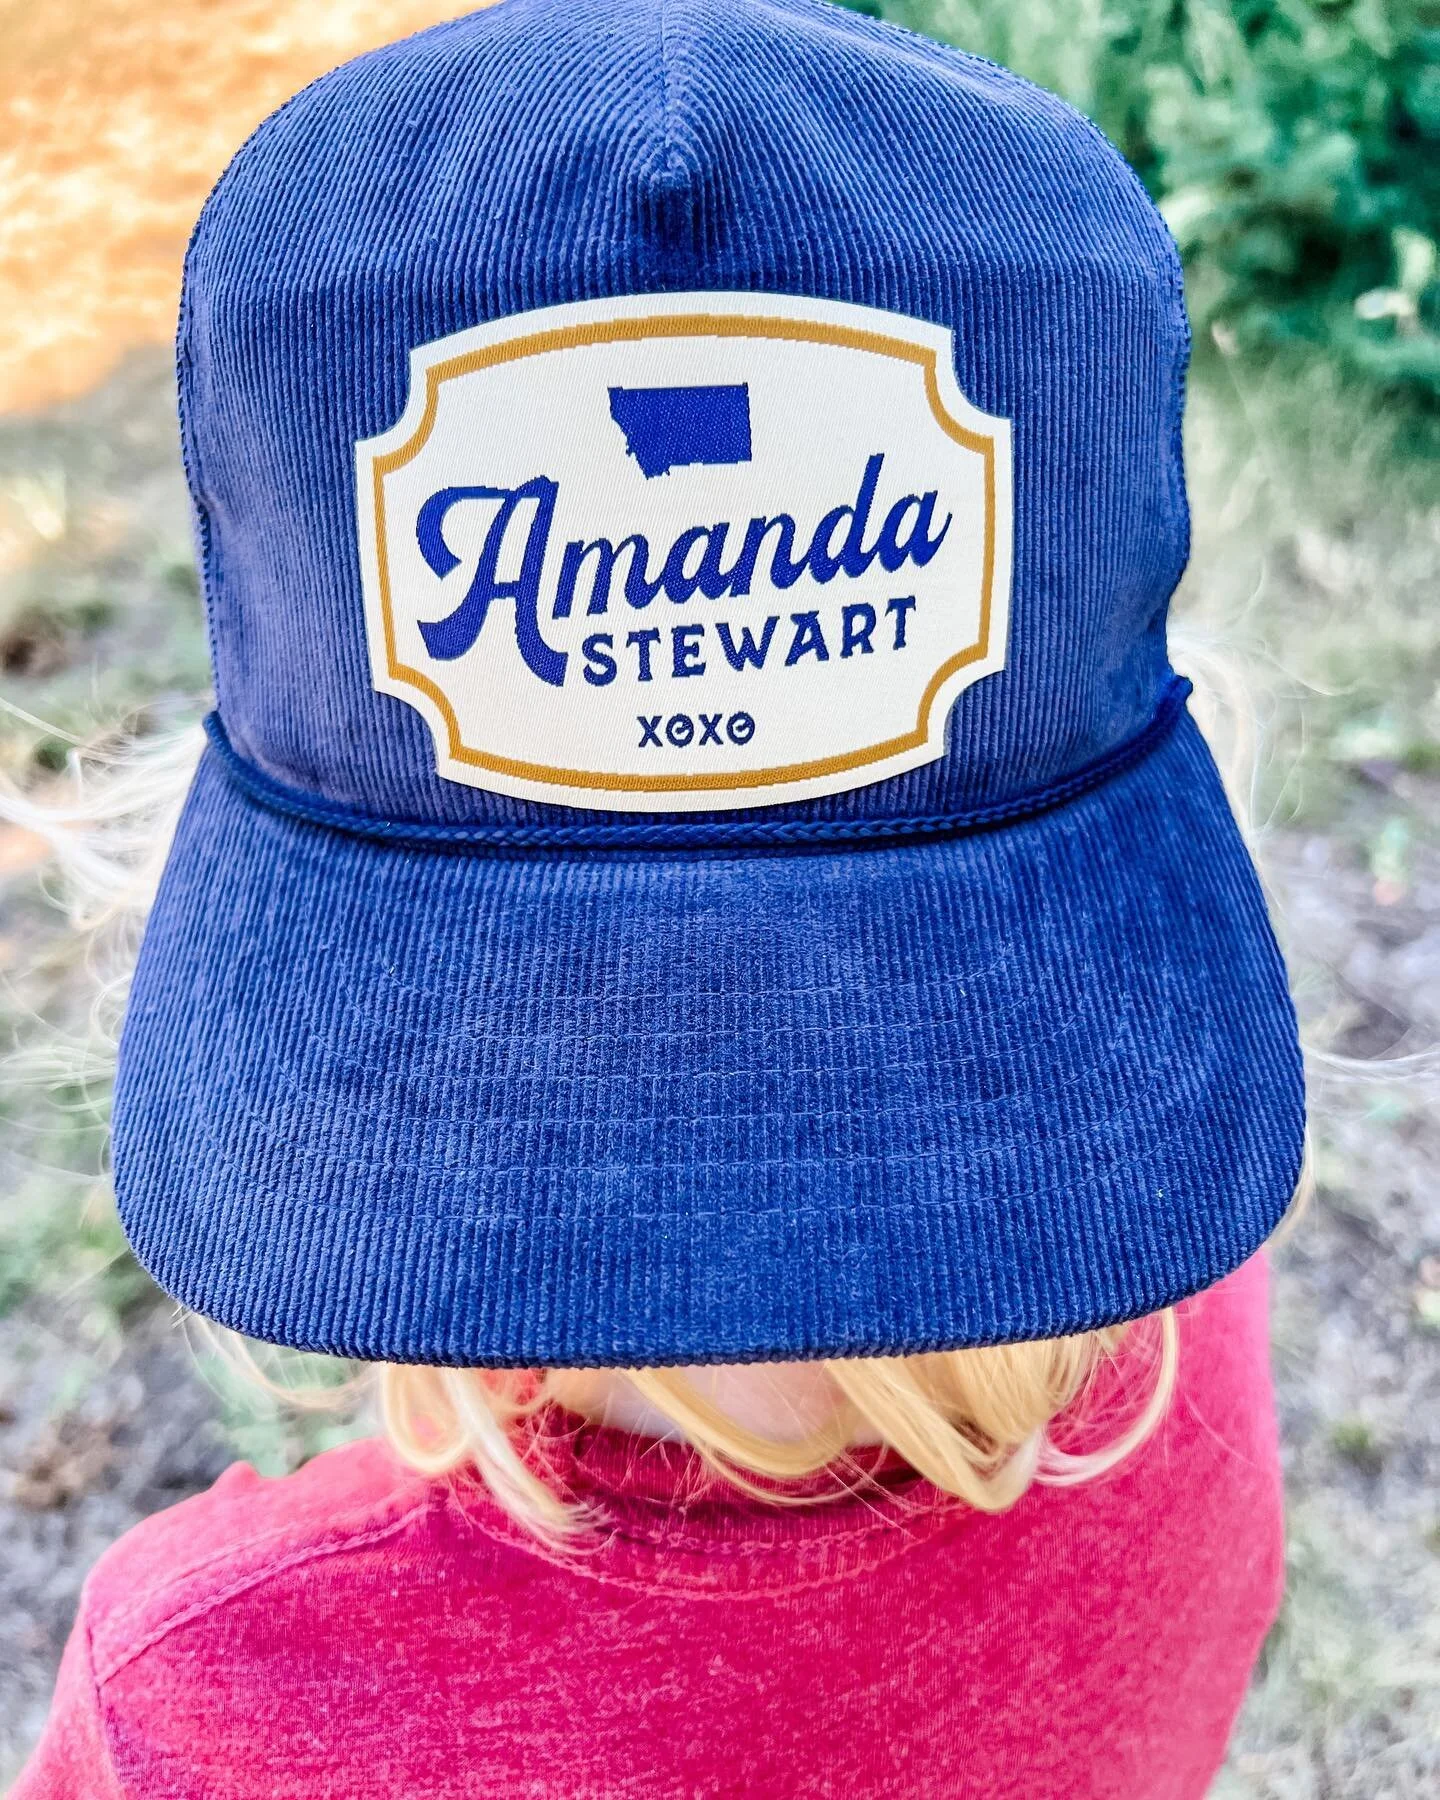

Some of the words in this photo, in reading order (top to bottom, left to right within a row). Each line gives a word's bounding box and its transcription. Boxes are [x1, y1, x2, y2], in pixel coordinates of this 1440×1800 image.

[416, 452, 952, 687] Amanda
[582, 596, 916, 687] STEWART
[637, 711, 756, 748] XOXO
